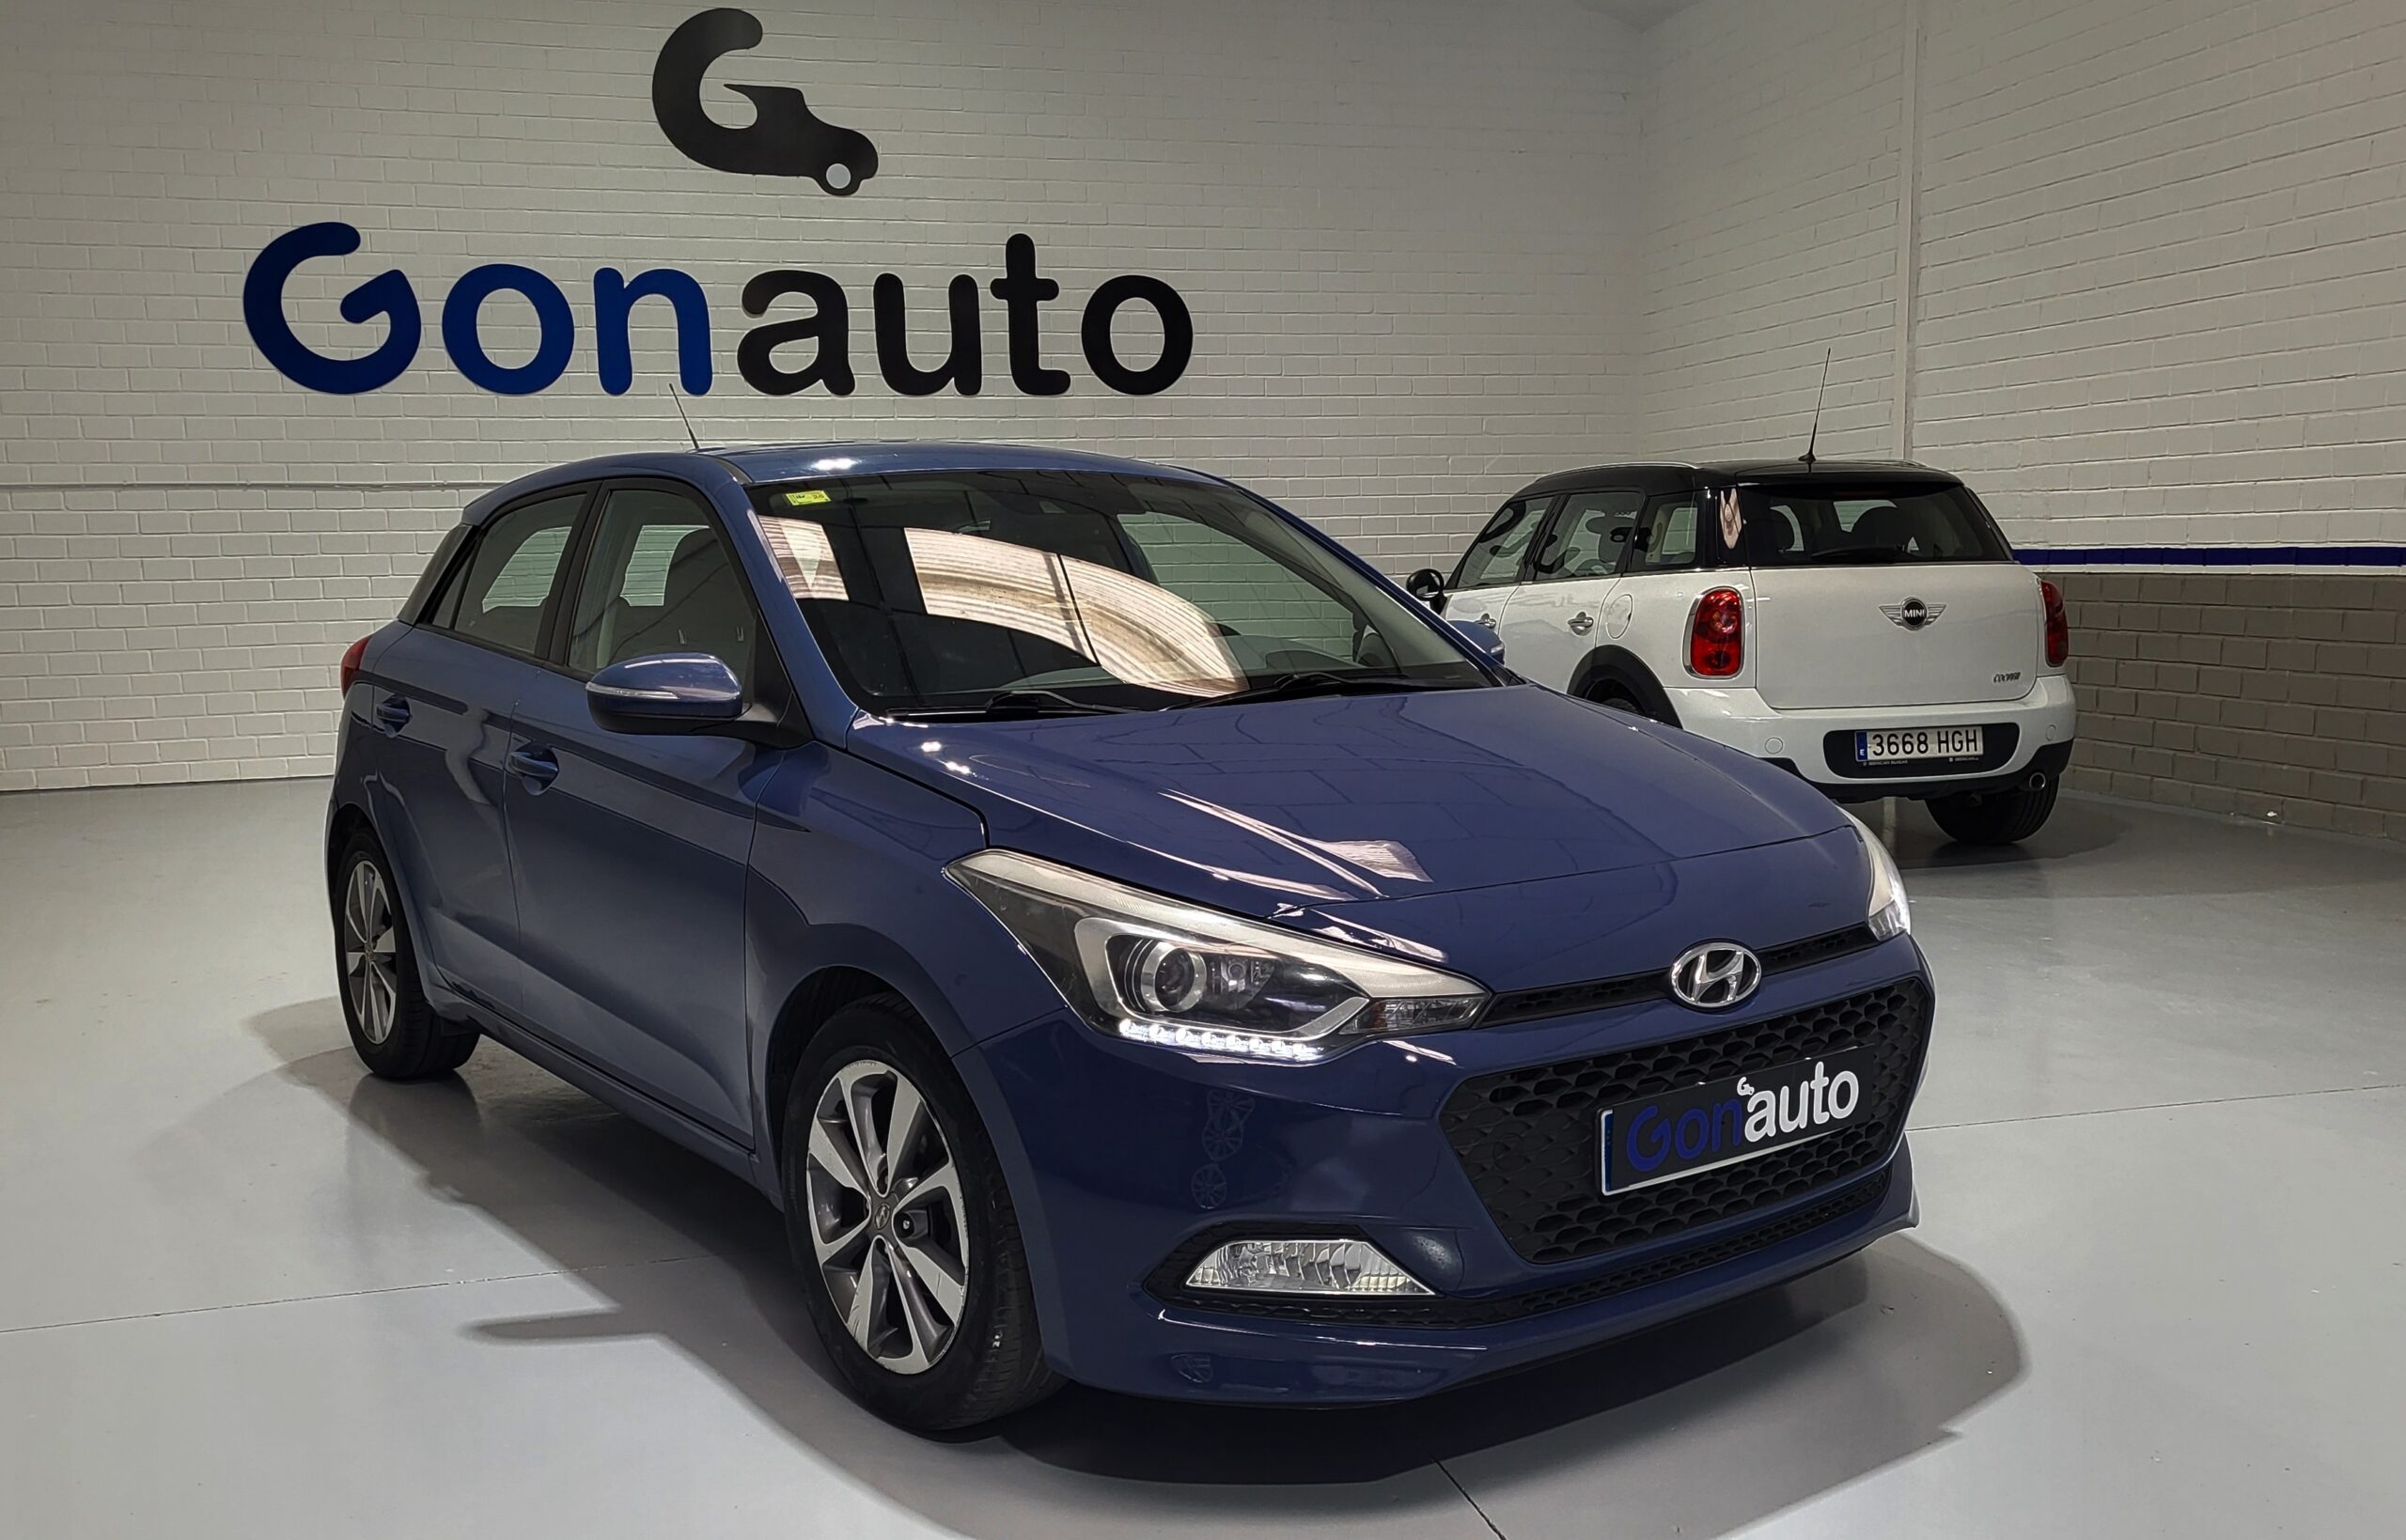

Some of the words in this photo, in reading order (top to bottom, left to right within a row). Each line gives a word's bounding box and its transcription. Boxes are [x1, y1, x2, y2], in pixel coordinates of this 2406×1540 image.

[242, 221, 1194, 397] Gonauto
[1904, 609, 1925, 618] MINI
[1871, 731, 1929, 756] 3668
[1937, 729, 1977, 754] HGH
[1626, 1061, 1860, 1173] Gonauto
